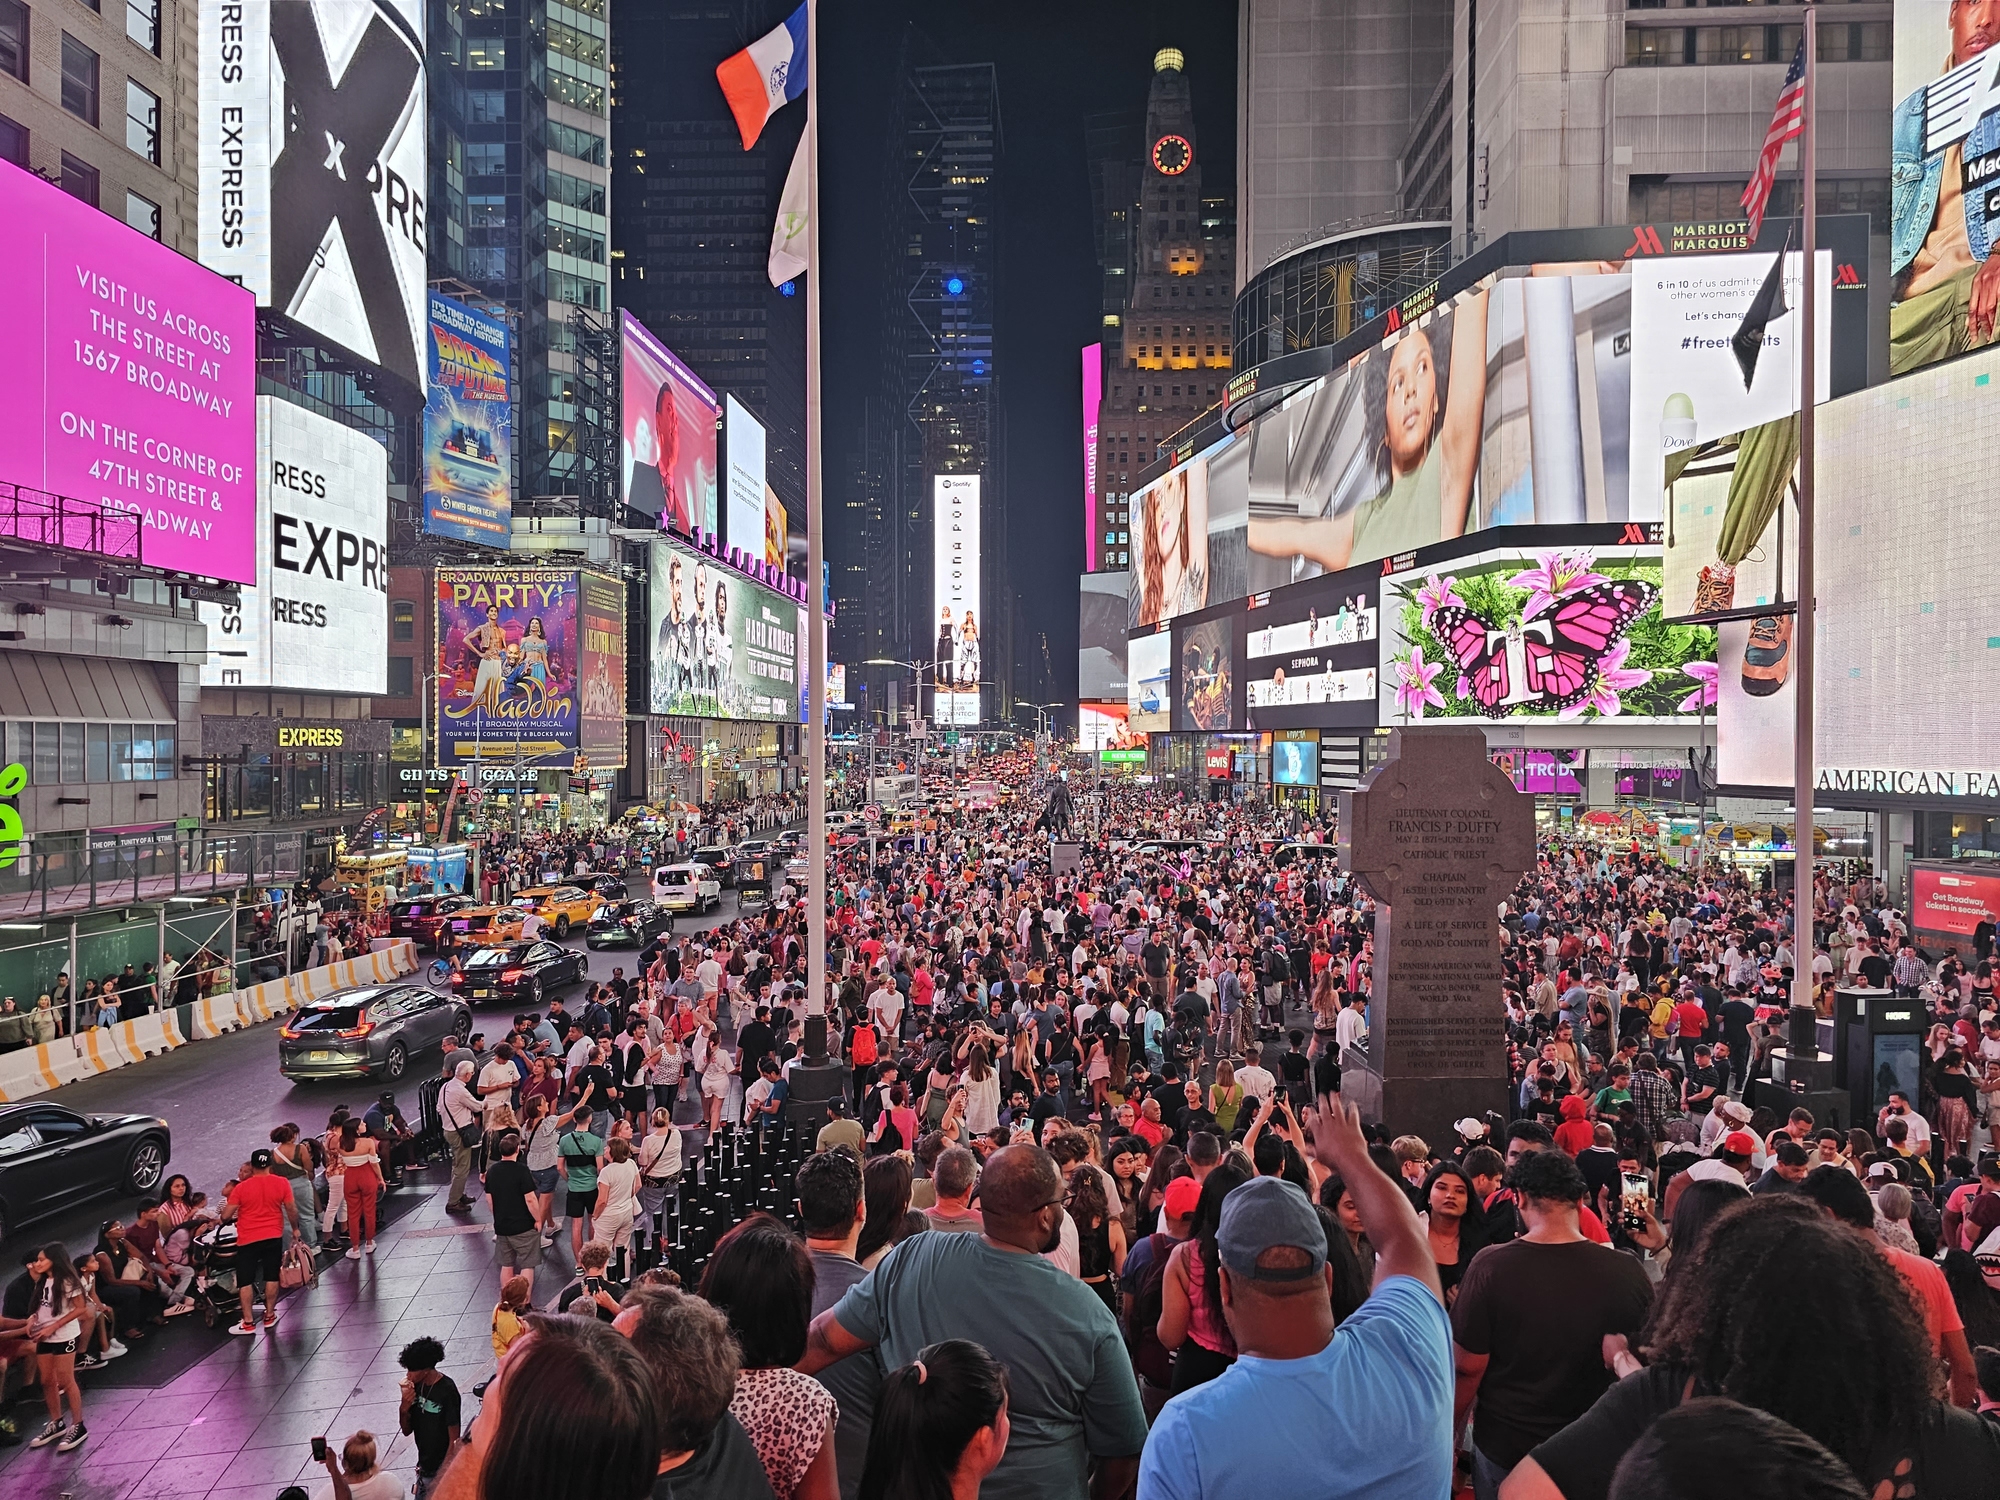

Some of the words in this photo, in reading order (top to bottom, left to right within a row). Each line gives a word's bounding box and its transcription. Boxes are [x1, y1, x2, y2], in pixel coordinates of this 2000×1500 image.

[221, 107, 243, 249] EXPRESS
[1673, 223, 1750, 237] MARRIOT
[1673, 237, 1747, 251] MARQUIS
[1657, 281, 1664, 290] 6
[1666, 280, 1676, 290] in
[1678, 280, 1689, 289] 10
[1692, 279, 1703, 288] of
[1705, 281, 1716, 289] us
[1719, 278, 1750, 287] admit
[1752, 278, 1762, 286] to
[1402, 280, 1439, 311] MARRIOTT
[1670, 290, 1697, 300] other
[1700, 289, 1746, 298] women's
[75, 264, 128, 308] VISIT
[133, 291, 158, 322] US
[162, 307, 232, 356] ACROSS
[1402, 297, 1435, 323] MARQUIS
[1685, 311, 1709, 321] Let's
[1712, 311, 1748, 322] chang
[432, 299, 446, 312] IT'S
[446, 306, 464, 322] TIME
[465, 314, 476, 327] TO
[476, 320, 504, 340] CHANGE
[432, 310, 473, 335] BROADWAY
[474, 328, 504, 349] HISTORY!
[89, 308, 127, 345] THE
[132, 326, 196, 373] STREET
[199, 359, 221, 383] AT
[430, 321, 506, 375] BACK
[1681, 333, 1781, 350] #freetits
[73, 339, 121, 375] 1567
[126, 360, 233, 419] BROADWAY
[455, 363, 506, 395] FUTURE
[1229, 368, 1260, 392] MARRIOTT
[1229, 380, 1256, 403] MARQUIS
[60, 411, 95, 441] ON
[101, 423, 138, 455] THE
[143, 437, 217, 479] CORNER
[221, 462, 243, 486] OF
[1664, 435, 1694, 448] Dove
[88, 458, 140, 490] 47TH
[145, 474, 207, 507] STREET
[211, 491, 223, 512] &
[275, 461, 326, 499] RESS
[101, 496, 213, 541] BROADWAY
[441, 572, 520, 583] BROADWAY'S
[522, 571, 574, 583] BIGGEST
[453, 584, 564, 608] PARTY!
[271, 596, 328, 628] RESS
[746, 617, 766, 648] HARD
[768, 625, 795, 656] KNOCKS
[1291, 656, 1319, 669] SEPHORA
[444, 676, 572, 719] Aladdin
[456, 720, 470, 728] THE
[486, 720, 529, 728] BROADWAY
[530, 720, 563, 728] MUSICAL
[279, 727, 344, 747] EXPRESS
[461, 769, 538, 781] LGGAGE
[1818, 769, 1955, 796] AMERICAN
[1395, 809, 1449, 818] LIEUTENANT
[1450, 809, 1493, 818] COLONEL
[1388, 821, 1442, 834] FRANCIS
[103, 838, 140, 848] OPPOTUNITY
[1395, 836, 1412, 844] MAY
[1464, 836, 1475, 844] 26
[1476, 836, 1495, 844] 1932
[1403, 851, 1449, 859] CATHOLIC
[1453, 851, 1487, 859] PRIEST
[1422, 873, 1466, 882] CHAPLAIN
[1925, 901, 1950, 911] tickets
[1932, 892, 1947, 901] Get
[1947, 894, 1984, 907] Broadway
[1415, 921, 1433, 929] LIFE
[1435, 921, 1447, 929] OF
[1450, 921, 1488, 929] SERVICE
[1401, 939, 1423, 948] GOD
[1425, 939, 1444, 948] AND
[1447, 939, 1490, 948] COUNTRY
[1398, 962, 1430, 970] SPANISH
[1431, 962, 1473, 970] AMERICAN
[1474, 962, 1492, 970] WAR
